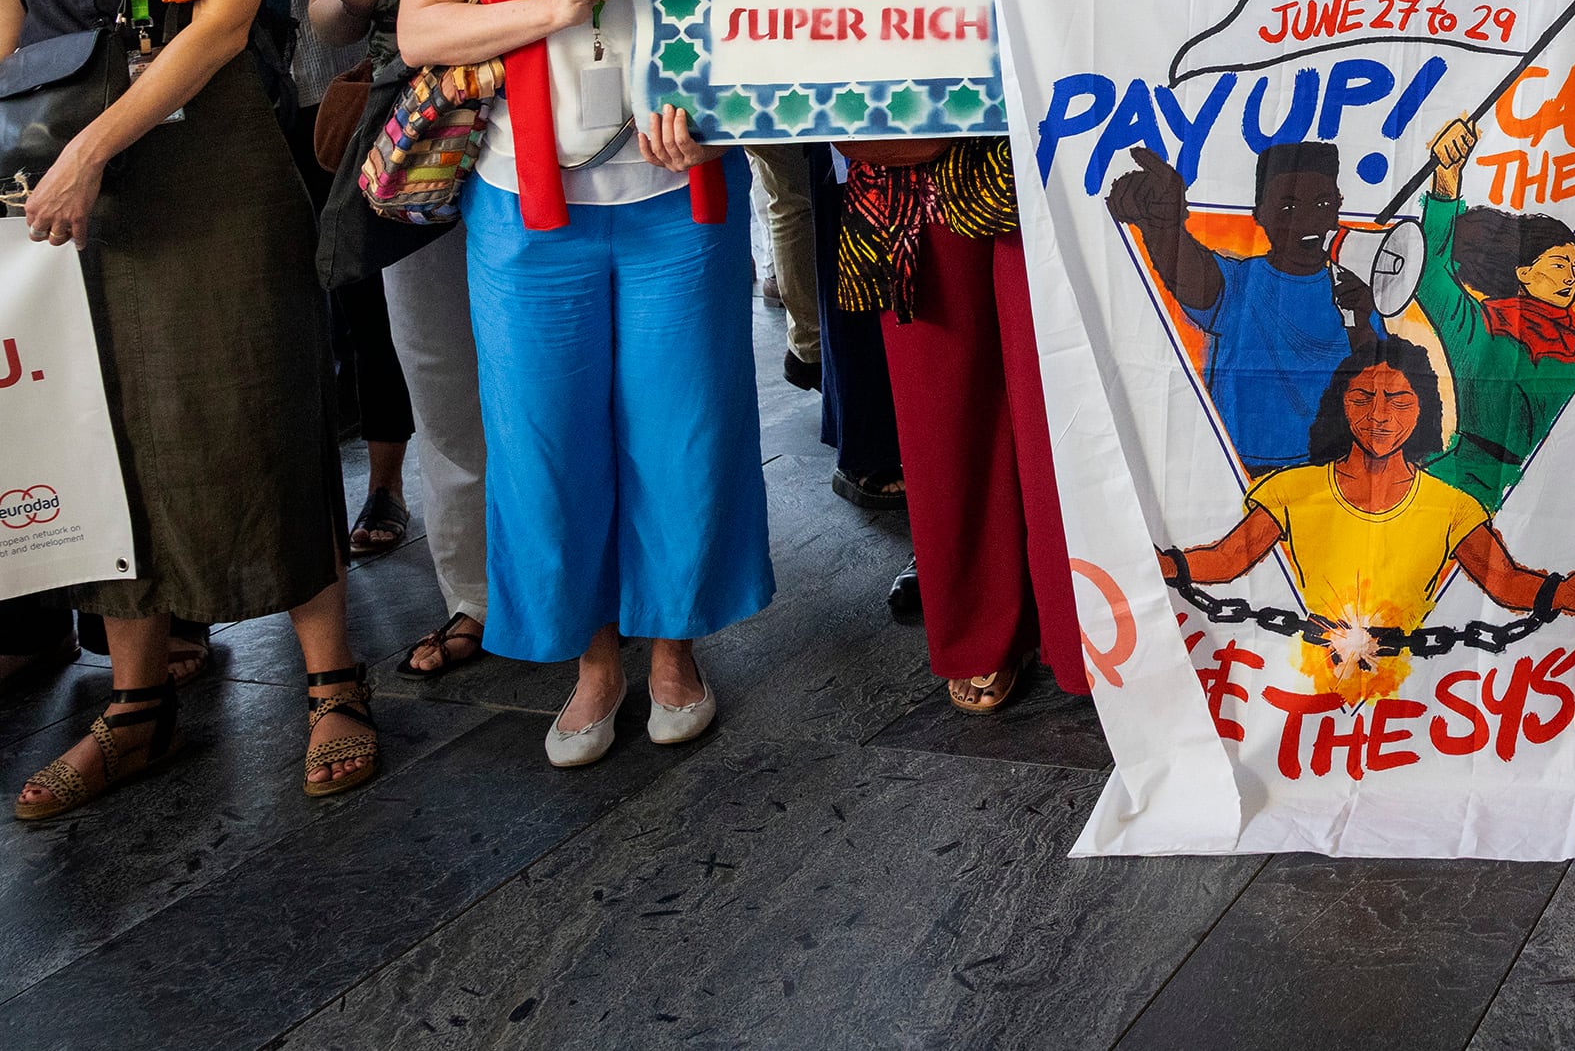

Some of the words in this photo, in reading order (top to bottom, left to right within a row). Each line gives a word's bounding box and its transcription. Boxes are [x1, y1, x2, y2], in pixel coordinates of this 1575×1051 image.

[719, 6, 868, 42] SUPER
[879, 5, 990, 42] RICH
[1426, 0, 1458, 36] to
[1464, 4, 1517, 43] 29
[1035, 71, 1239, 197] PAY
[1241, 55, 1449, 186] UP!
[0, 494, 60, 519] eurodad
[0, 534, 30, 548] ropean
[32, 526, 69, 540] network
[70, 524, 81, 533] on
[11, 545, 28, 556] and
[30, 533, 85, 551] development
[1260, 684, 1428, 781] THE
